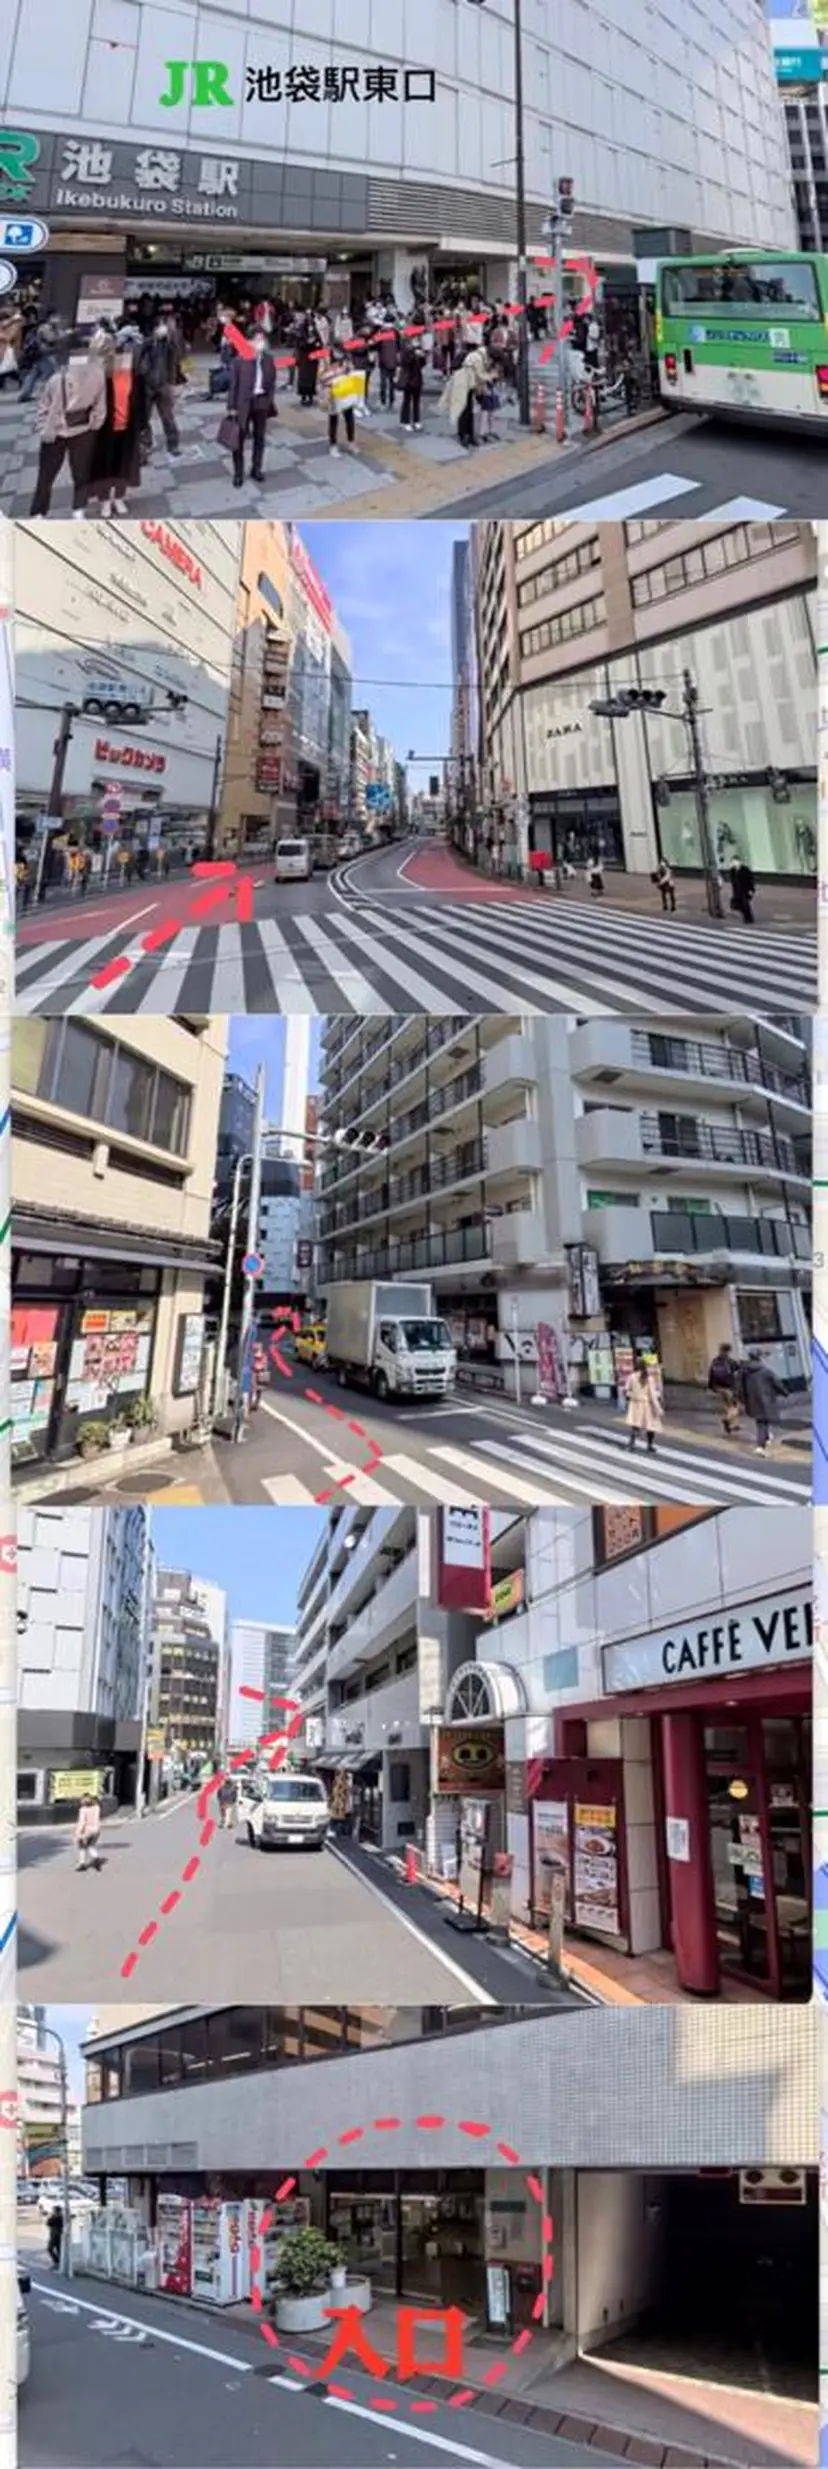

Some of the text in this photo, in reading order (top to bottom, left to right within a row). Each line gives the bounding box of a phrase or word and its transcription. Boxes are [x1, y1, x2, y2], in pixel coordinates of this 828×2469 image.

[61, 141, 242, 197] 池袋駅
[56, 189, 168, 214] Ikebukuro
[171, 199, 239, 219] Station
[141, 521, 201, 590] CAMERA
[95, 738, 167, 774] ビックカメラ
